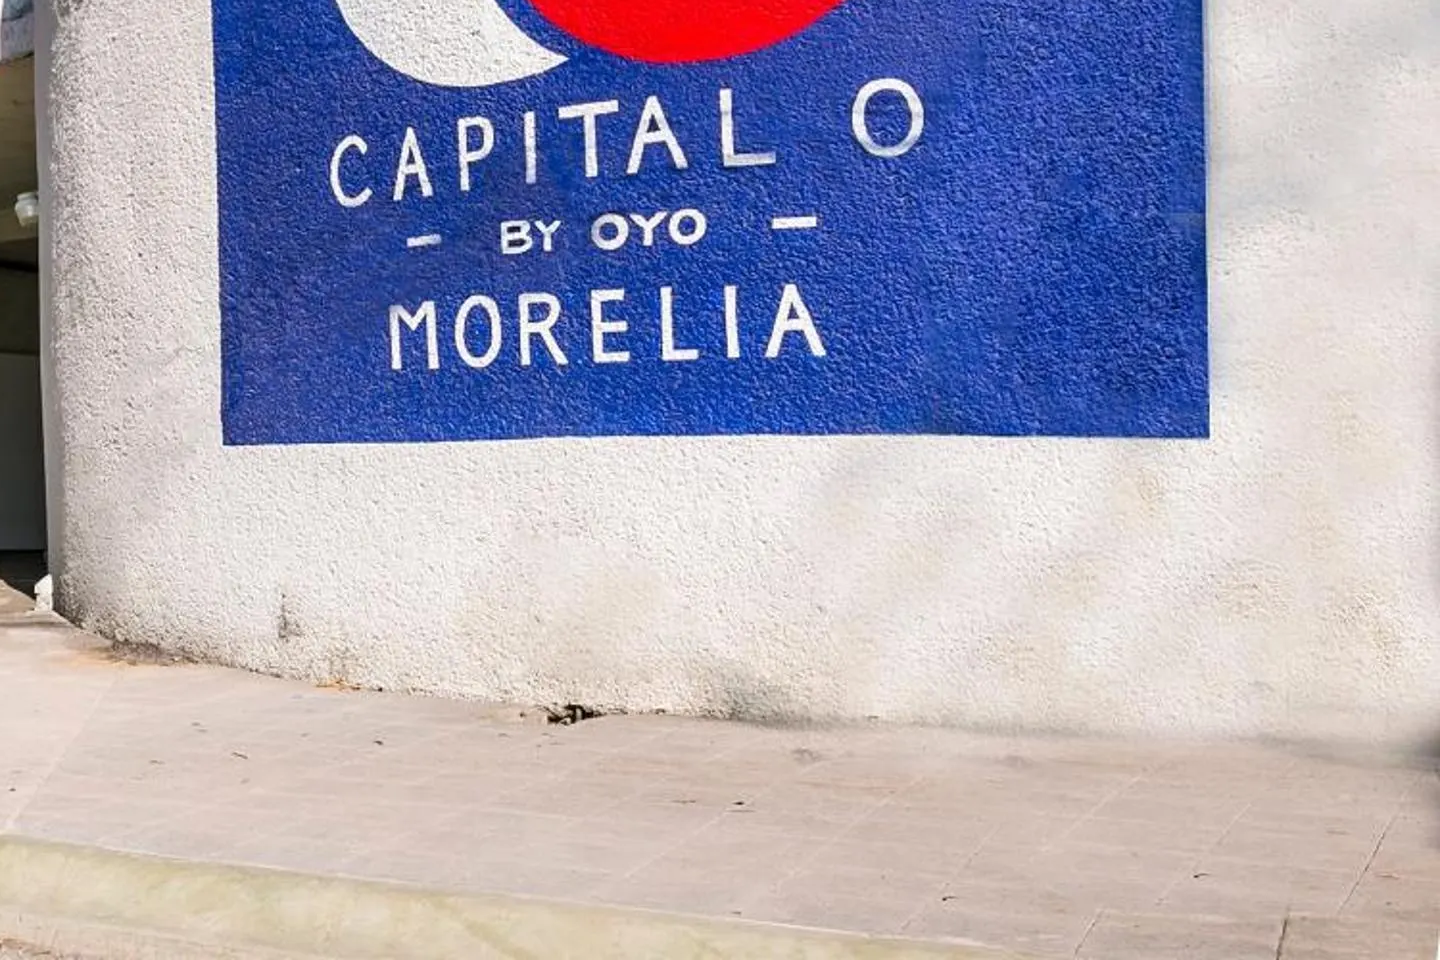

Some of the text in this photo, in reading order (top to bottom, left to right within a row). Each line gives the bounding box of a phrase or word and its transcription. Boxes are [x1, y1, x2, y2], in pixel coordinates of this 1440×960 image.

[328, 77, 925, 209] CAPITAL O
[499, 207, 708, 255] BY OYO
[387, 282, 827, 371] MORELIA
